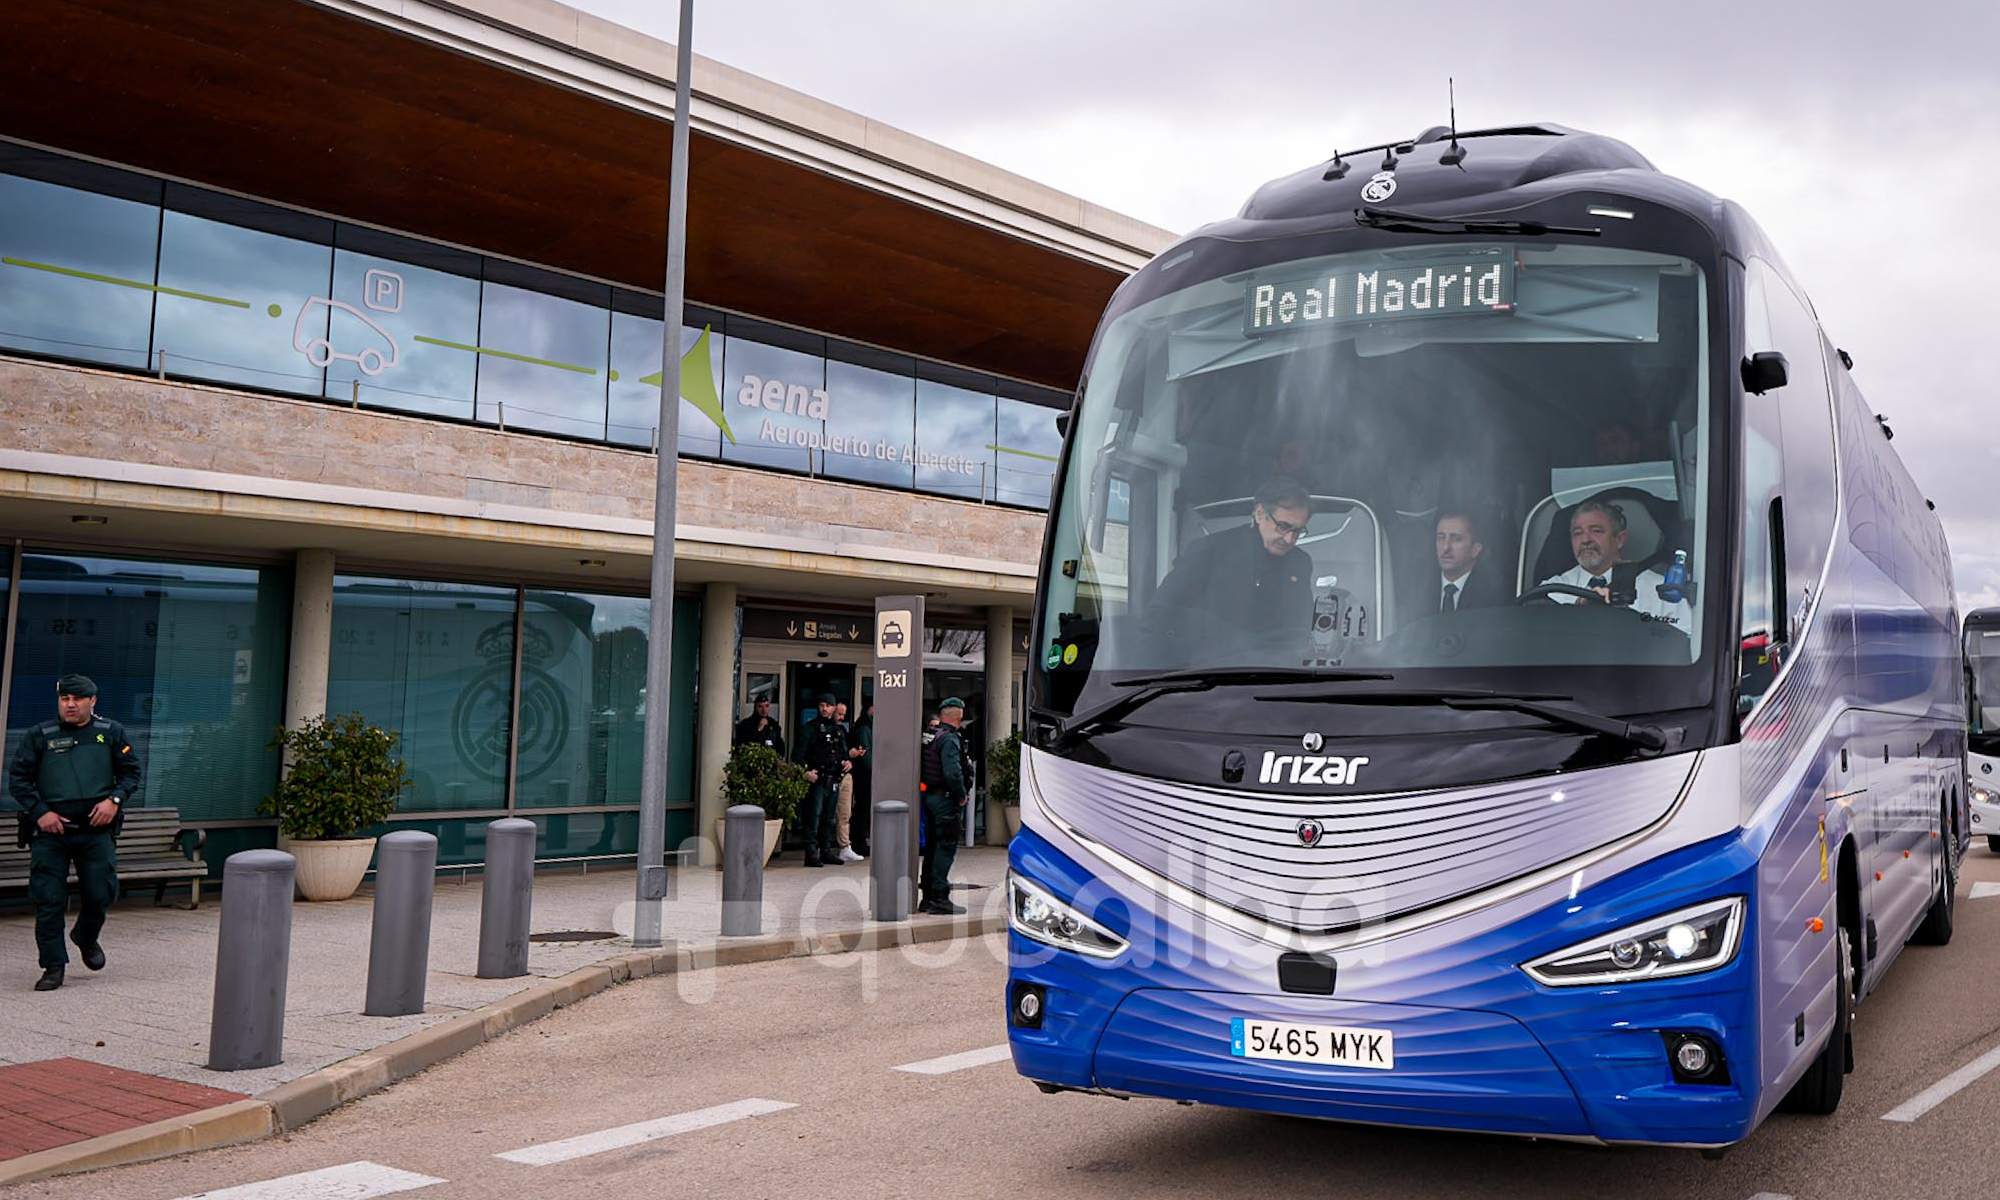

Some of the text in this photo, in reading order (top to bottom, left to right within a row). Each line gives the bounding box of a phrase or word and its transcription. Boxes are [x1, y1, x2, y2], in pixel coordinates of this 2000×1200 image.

[1254, 264, 1500, 327] Real Madrid
[738, 374, 830, 421] aena
[760, 418, 870, 458] Aeropuerto
[875, 440, 902, 462] de
[878, 669, 907, 689] Taxi
[1259, 750, 1369, 786] Irizar
[1251, 1025, 1385, 1063] 5465 MYK
